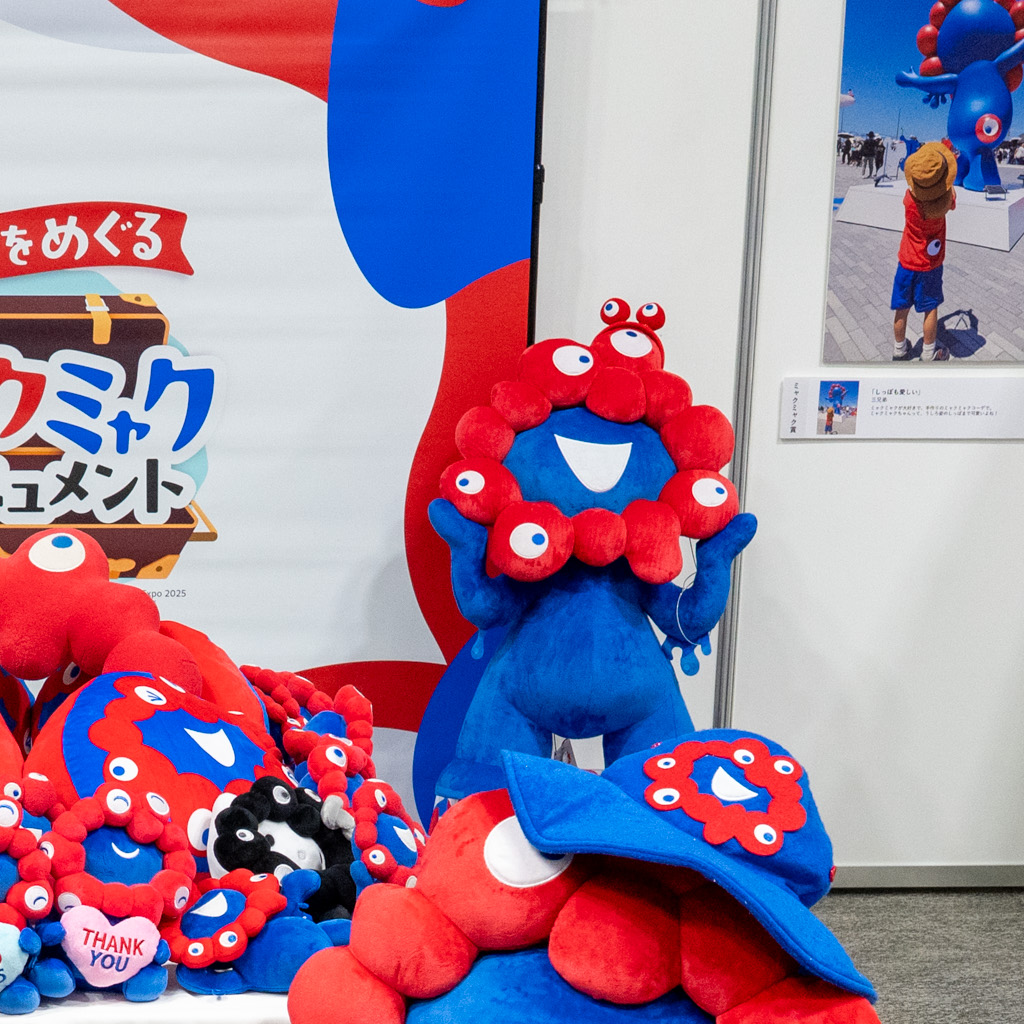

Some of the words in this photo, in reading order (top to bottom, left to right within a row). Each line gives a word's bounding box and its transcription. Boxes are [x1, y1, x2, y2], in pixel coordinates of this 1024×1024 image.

[164, 589, 187, 598] 2025
[82, 927, 146, 957] THANK
[89, 950, 131, 973] YOU
